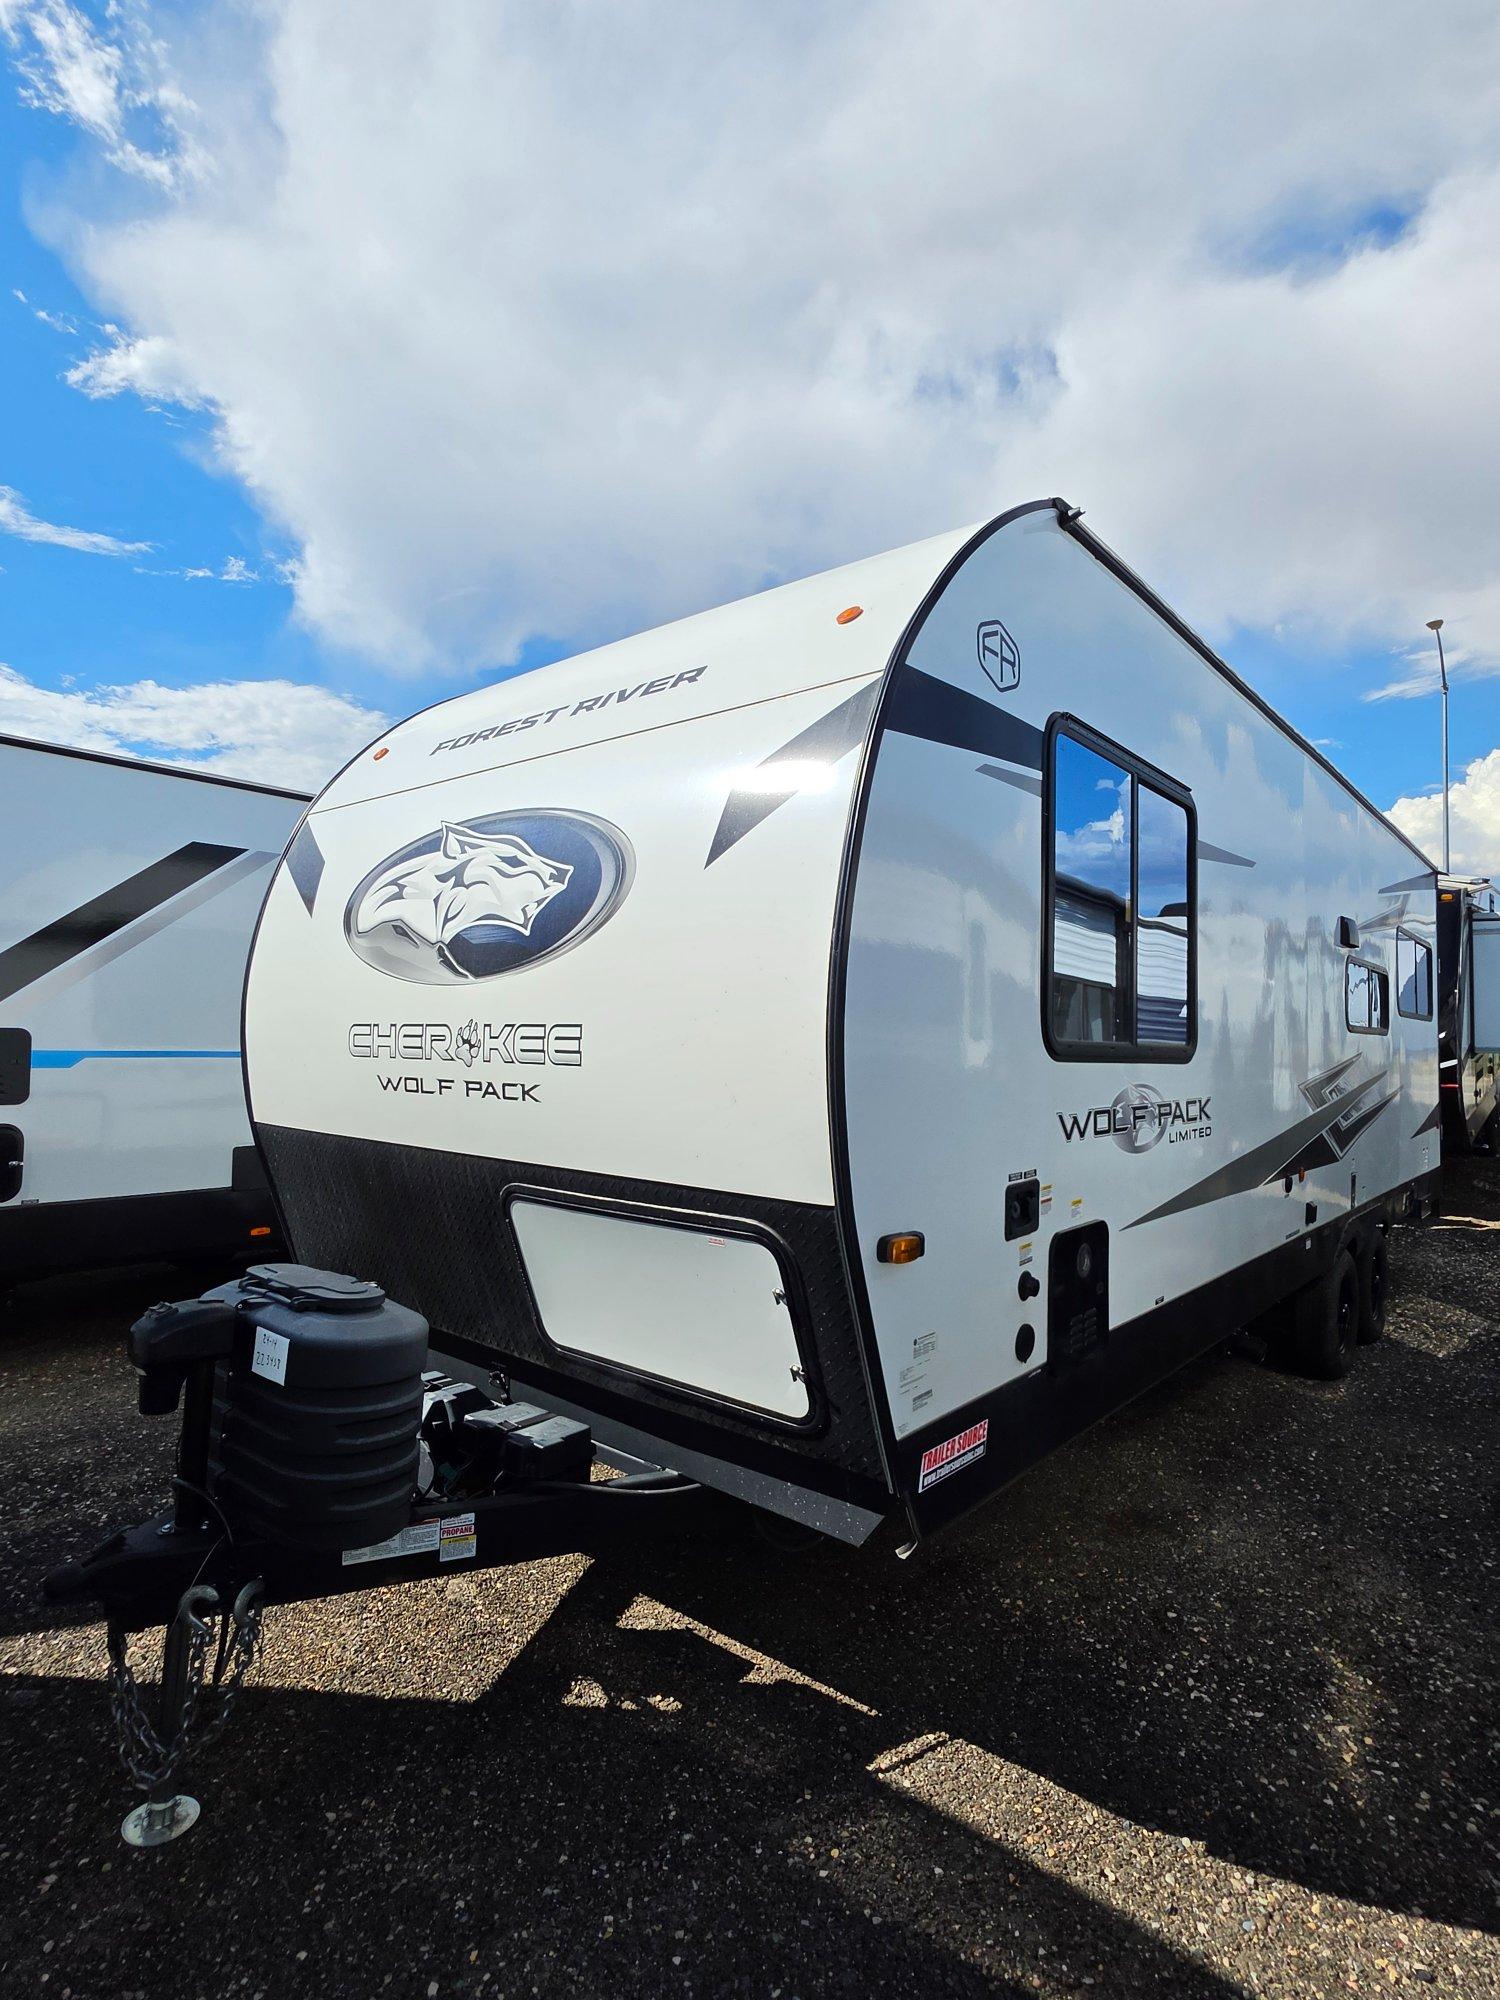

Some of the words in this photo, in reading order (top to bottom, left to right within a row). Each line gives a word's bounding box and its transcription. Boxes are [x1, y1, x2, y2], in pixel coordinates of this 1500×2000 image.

[429, 705, 570, 756] FOREST
[570, 665, 708, 717] RIVER
[376, 1075, 455, 1095] WOLF
[463, 1080, 542, 1103] PACK
[1056, 1103, 1149, 1143] WOLF
[1155, 1097, 1212, 1127] PACK
[1168, 1126, 1212, 1144] LIMITED
[923, 1438, 956, 1473] TRAILER
[957, 1421, 987, 1453] SOURCE
[441, 1525, 473, 1537] PROPANE
